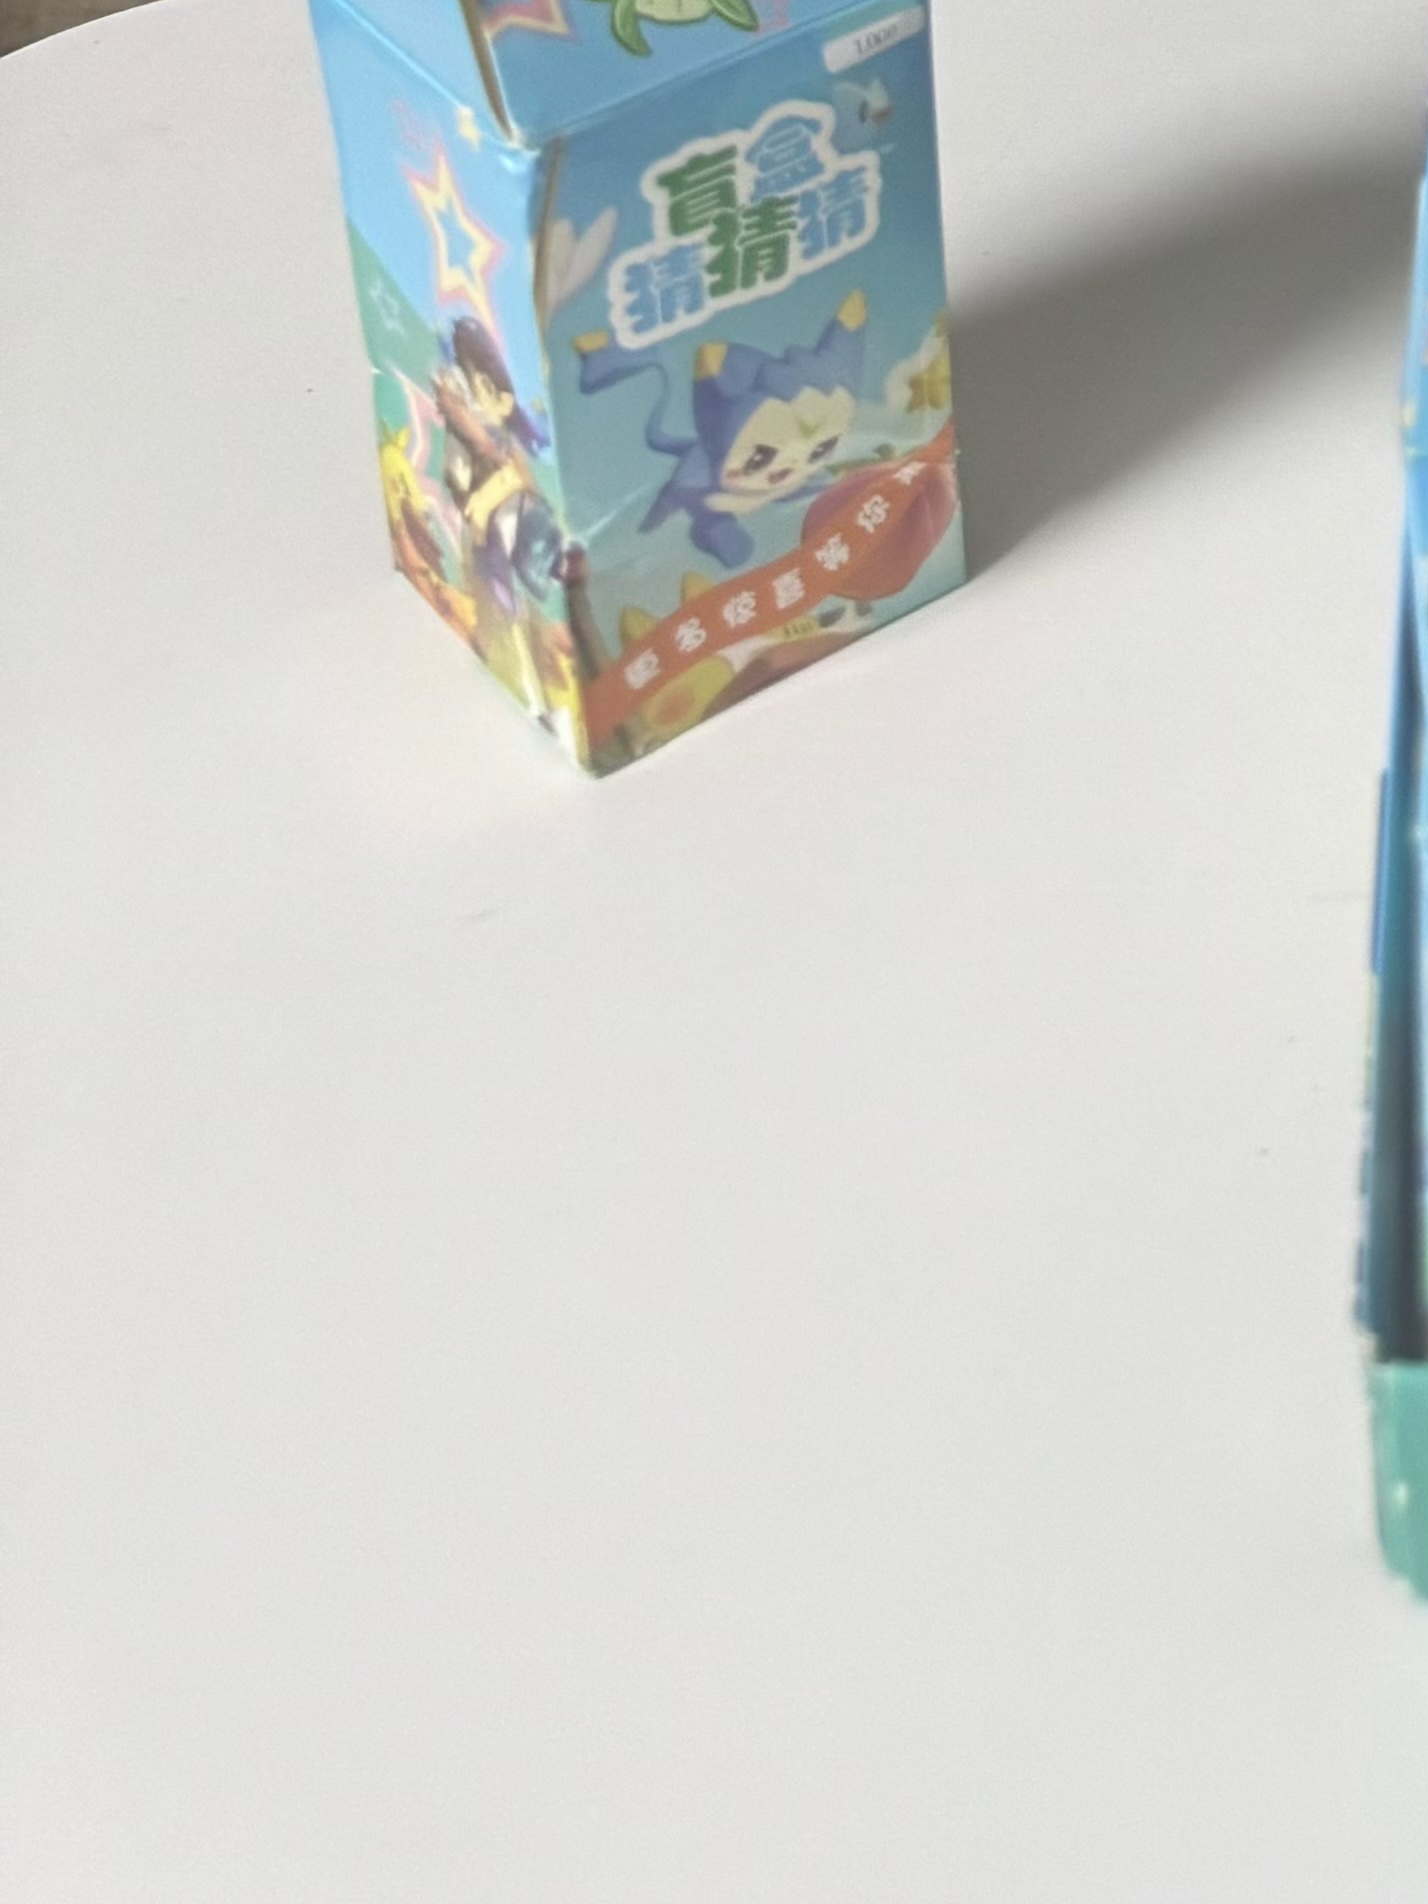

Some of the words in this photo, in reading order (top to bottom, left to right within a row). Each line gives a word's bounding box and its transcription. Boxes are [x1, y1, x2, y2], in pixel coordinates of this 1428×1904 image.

[655, 113, 828, 238] 盲盒
[624, 166, 867, 335] 猜猜猜
